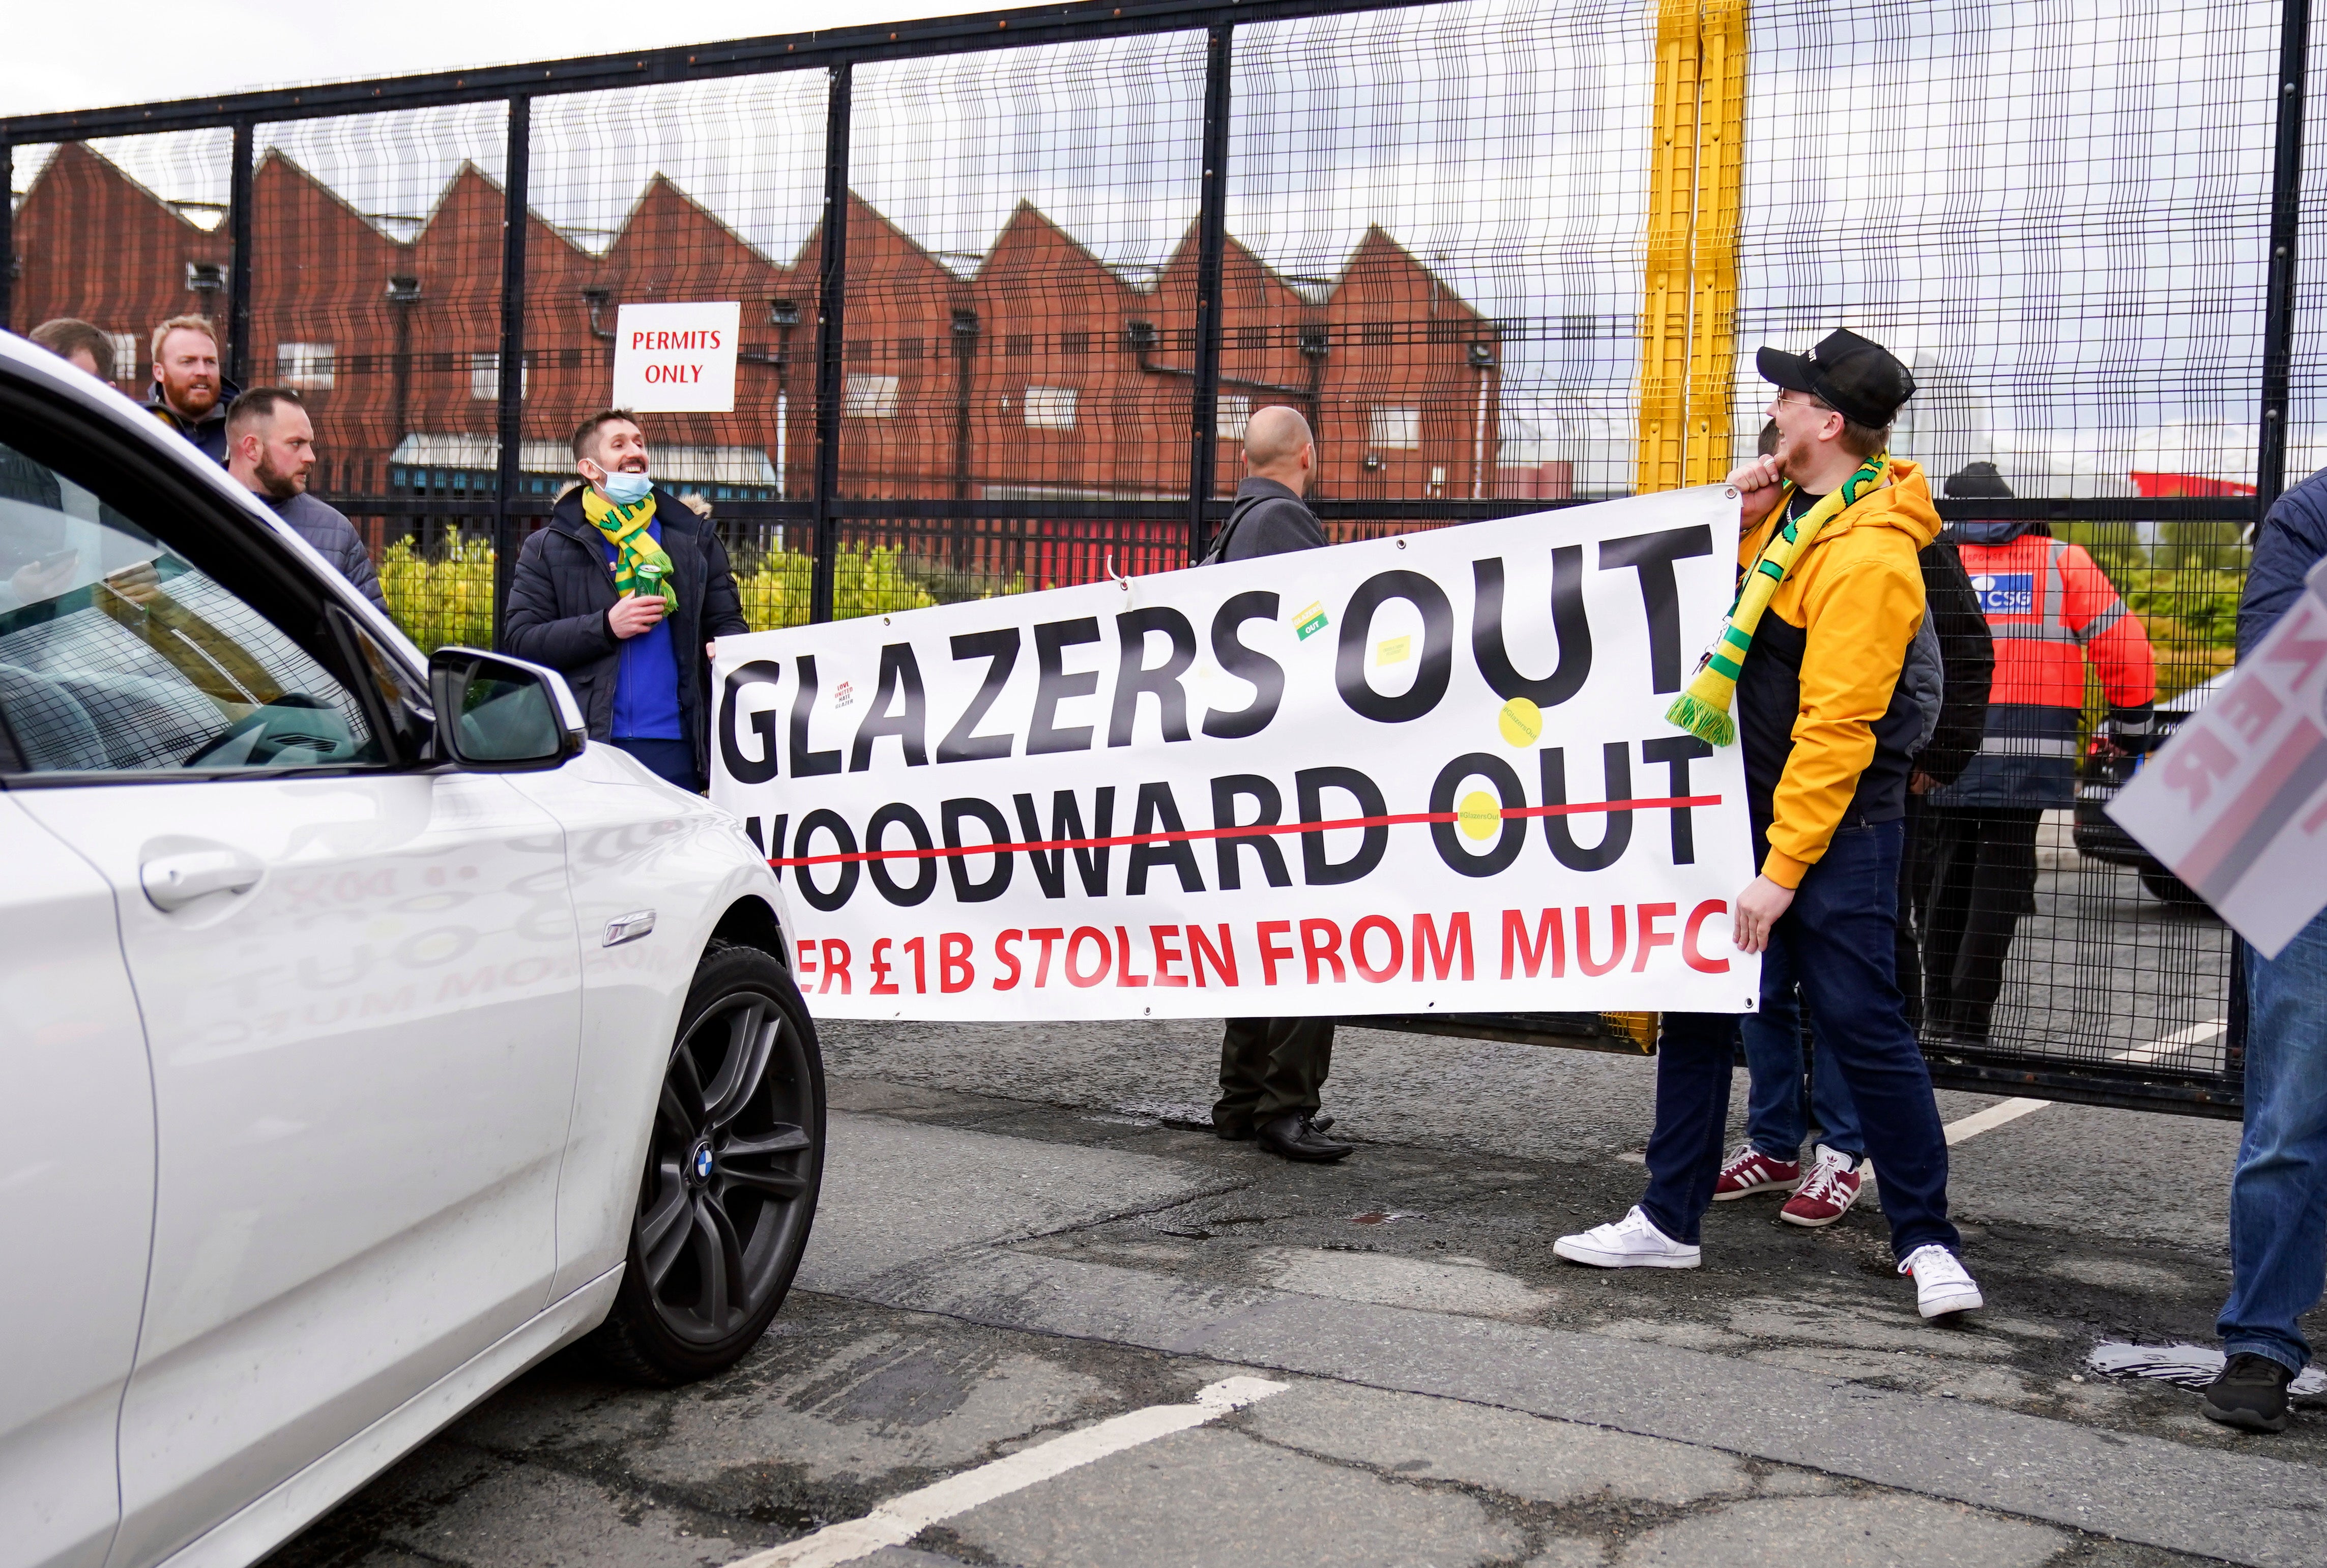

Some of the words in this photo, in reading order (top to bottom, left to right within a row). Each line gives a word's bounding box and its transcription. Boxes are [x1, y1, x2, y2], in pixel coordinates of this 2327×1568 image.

[632, 331, 720, 350] PERMITS
[645, 365, 703, 383] ONLY
[1988, 591, 2030, 607] CSG
[1305, 621, 1319, 634] OUT
[718, 590, 1286, 785] GLAZERS
[1335, 523, 1713, 724] OUT
[837, 681, 849, 691] LOVE
[1502, 707, 1537, 740] #GlazersOut
[1428, 736, 1713, 878] OUT
[1459, 811, 1499, 820] #GlazersOut
[869, 932, 975, 995] £1B
[993, 923, 1239, 992] STOLEN
[1256, 911, 1474, 986] FROM
[1501, 898, 1731, 980] MUFC
